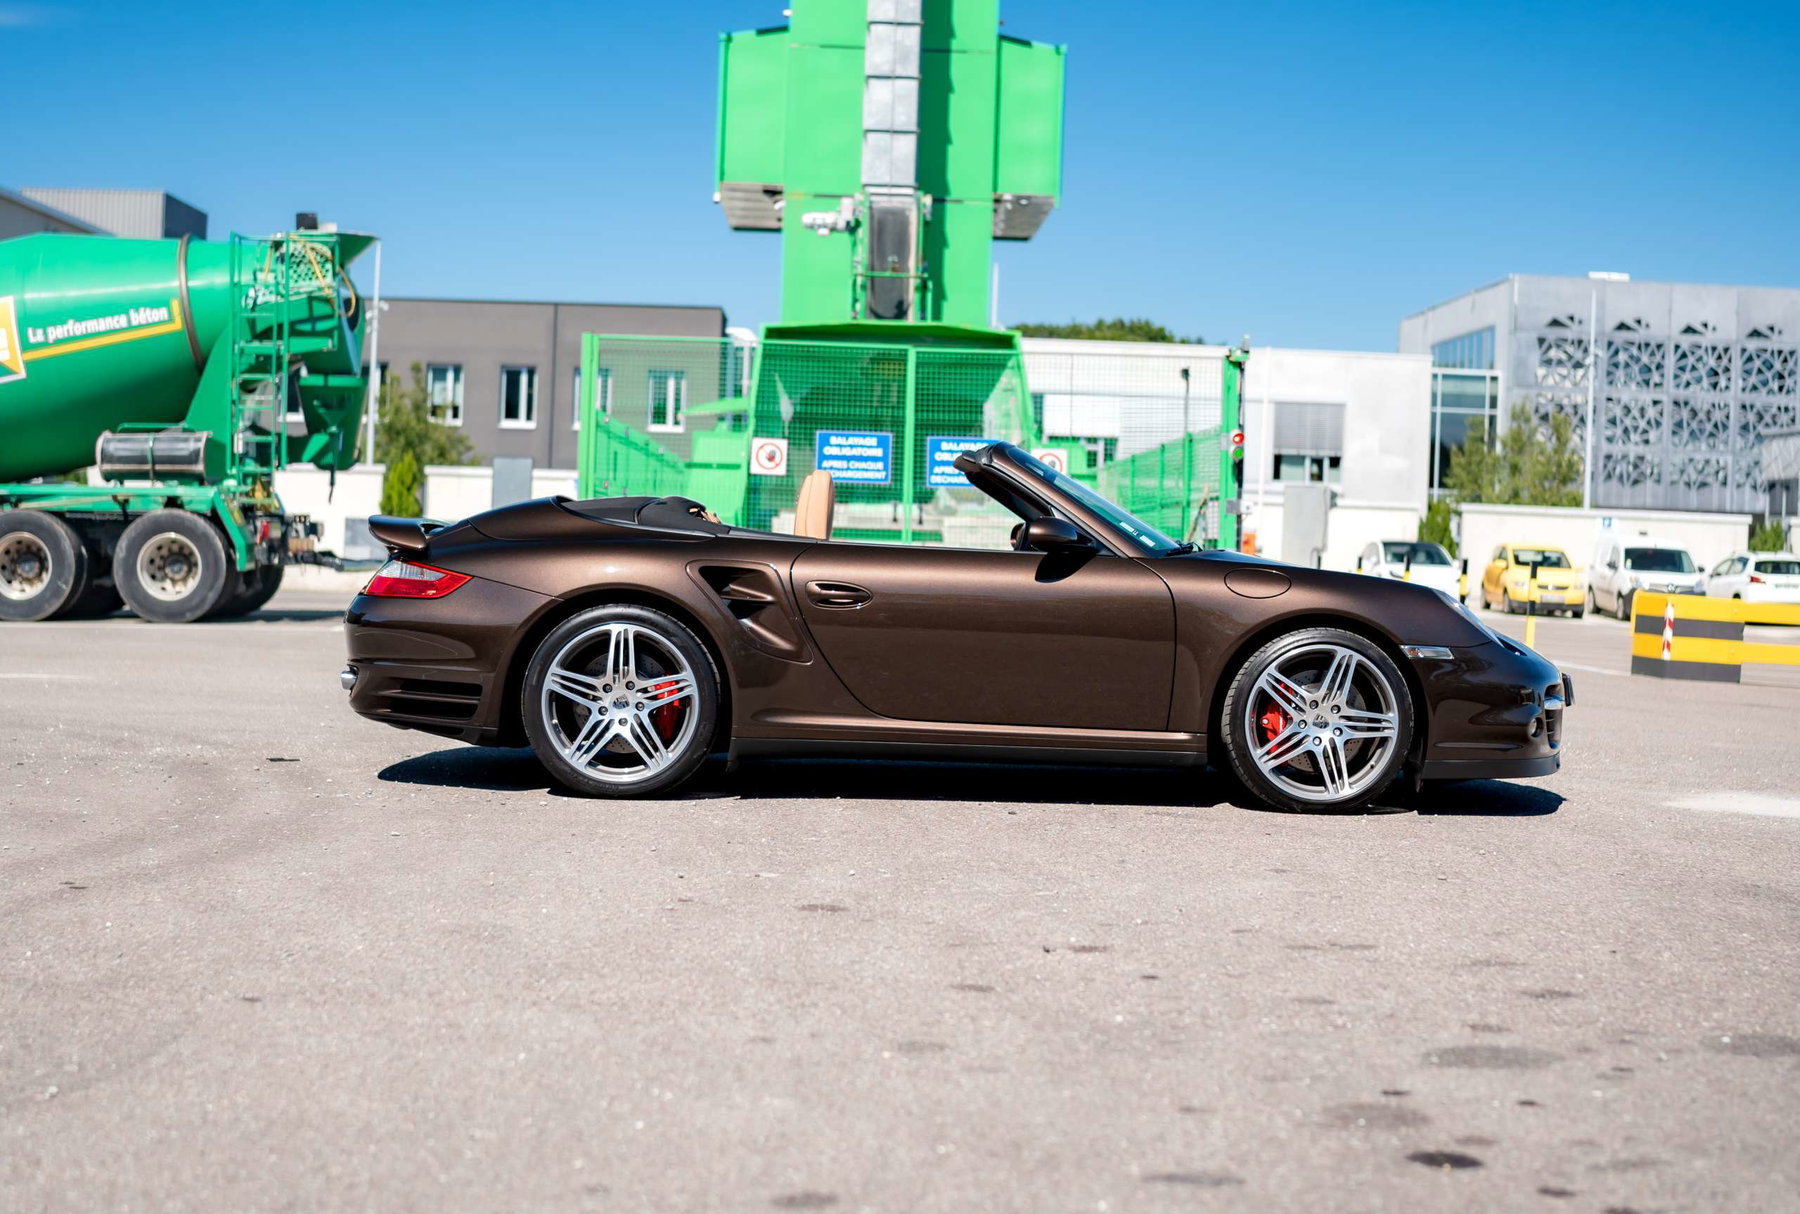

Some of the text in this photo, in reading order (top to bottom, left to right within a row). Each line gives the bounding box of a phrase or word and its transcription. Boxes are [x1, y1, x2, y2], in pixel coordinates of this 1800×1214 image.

[28, 307, 168, 343] La performance béton
[829, 436, 877, 446] BALAYAGE
[823, 446, 883, 457] OBLIGATOIRE
[849, 461, 884, 470] CHAQUE
[827, 470, 886, 479] CHARGEMENT
